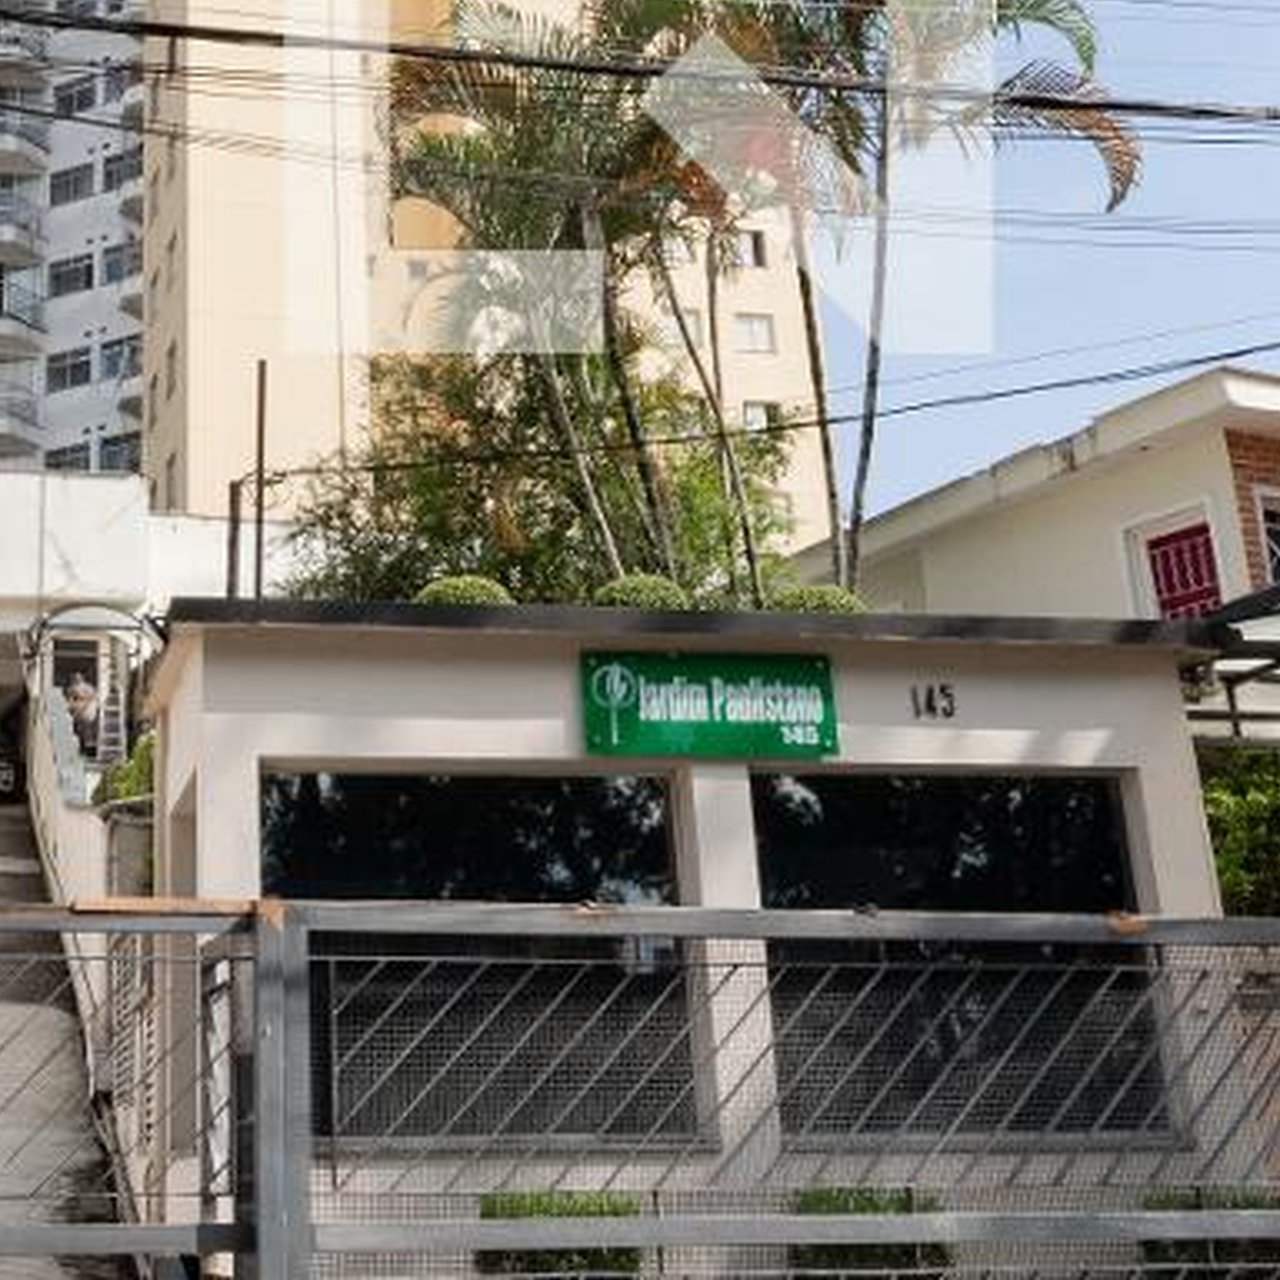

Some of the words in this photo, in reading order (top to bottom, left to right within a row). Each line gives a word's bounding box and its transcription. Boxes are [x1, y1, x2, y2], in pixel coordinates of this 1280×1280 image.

[638, 675, 710, 722] Jardim
[711, 675, 824, 724] Paulistano
[909, 684, 956, 719] 145
